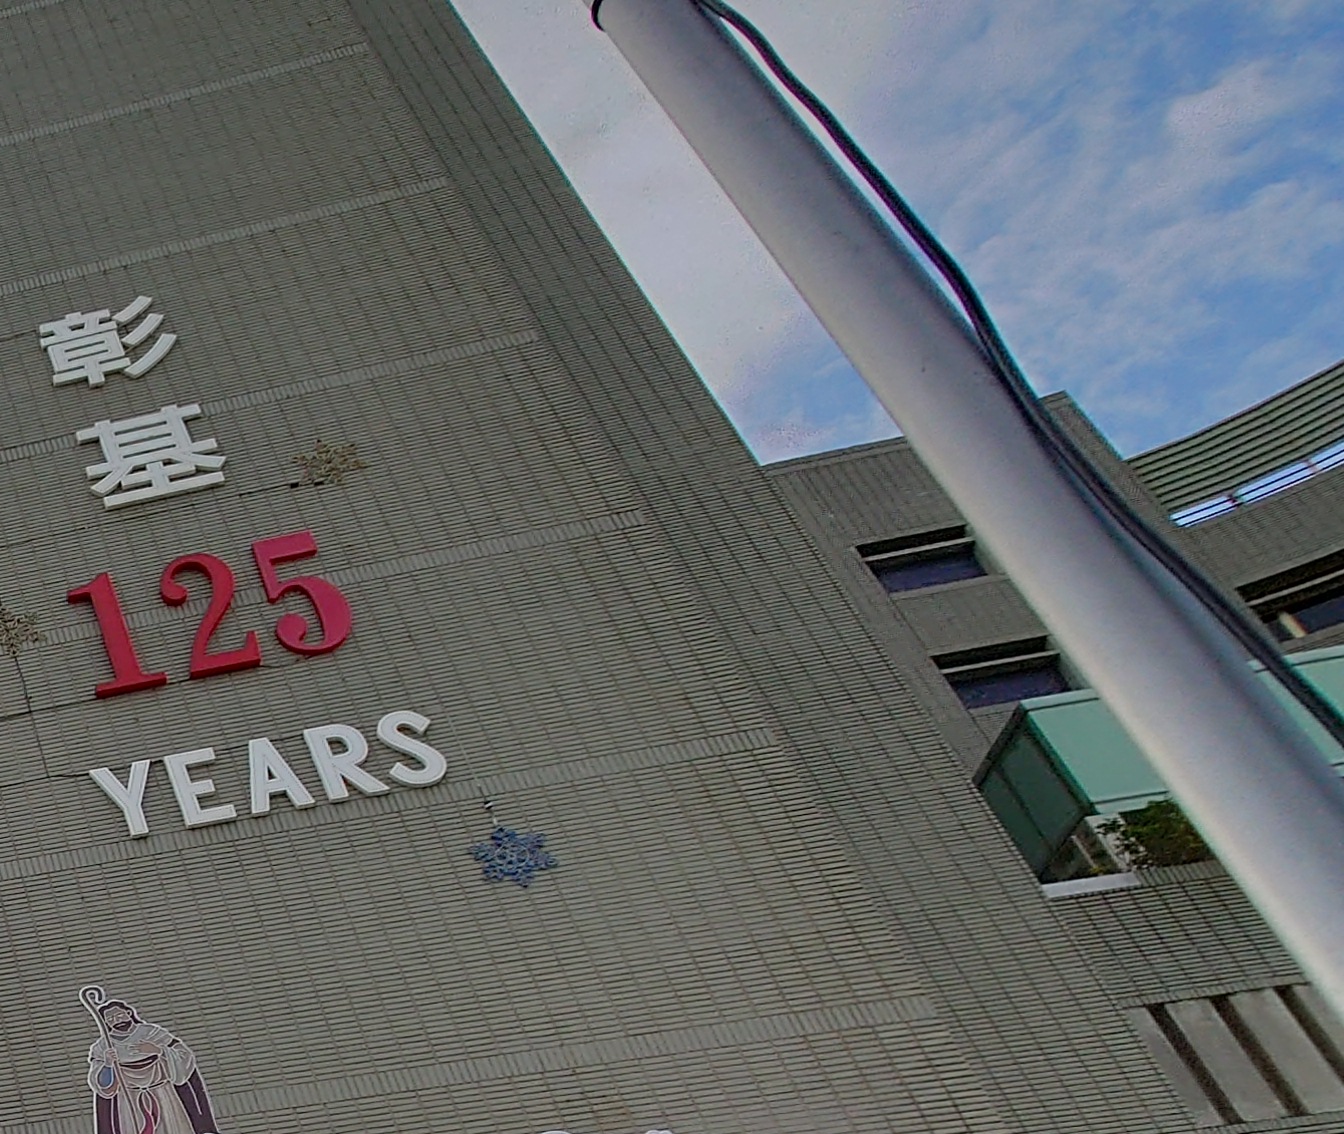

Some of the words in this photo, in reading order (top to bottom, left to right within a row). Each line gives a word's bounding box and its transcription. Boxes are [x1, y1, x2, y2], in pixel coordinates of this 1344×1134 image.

[39, 295, 226, 508] 彰基
[67, 530, 354, 698] 125
[89, 710, 448, 838] YEARS
